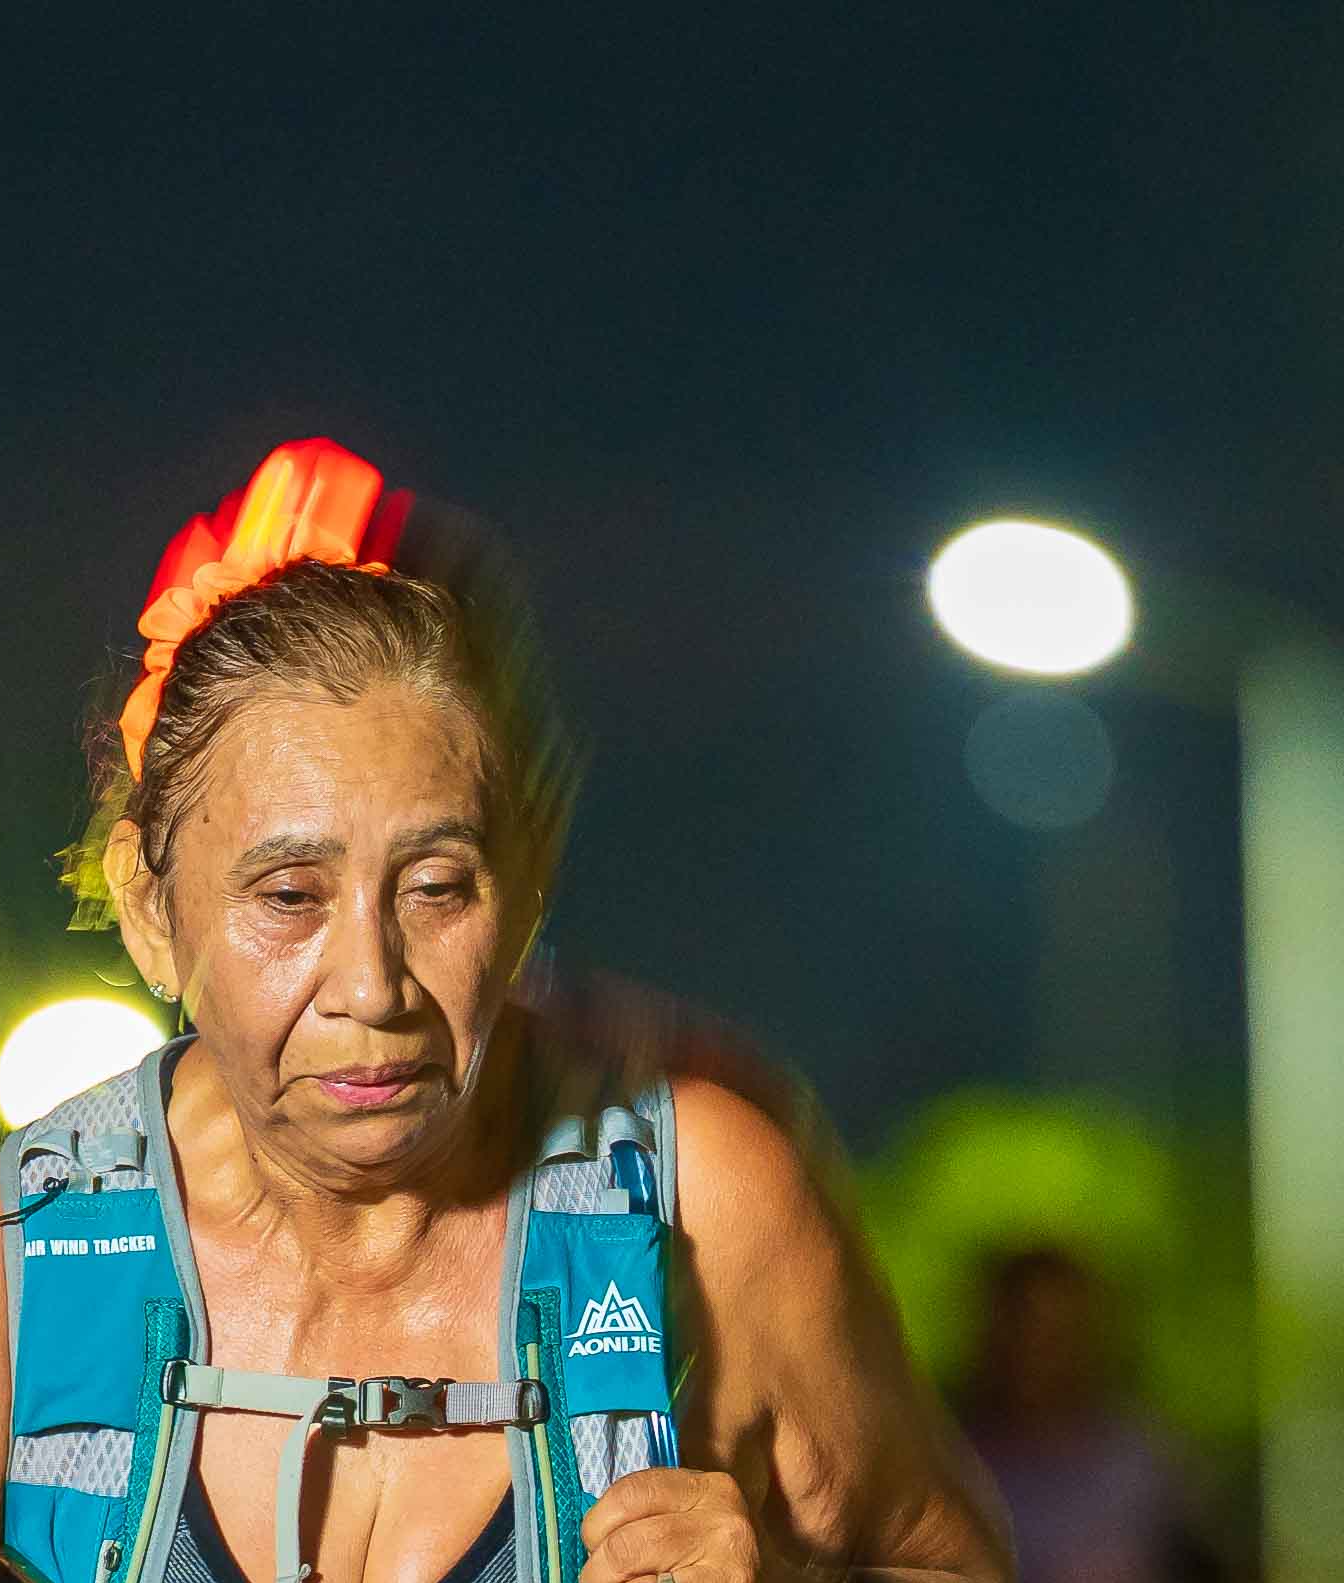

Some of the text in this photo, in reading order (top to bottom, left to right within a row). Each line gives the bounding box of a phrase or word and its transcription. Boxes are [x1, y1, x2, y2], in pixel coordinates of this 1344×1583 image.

[24, 1234, 157, 1257] AIR WIND TRACKER
[567, 1335, 663, 1358] AONIJIE
